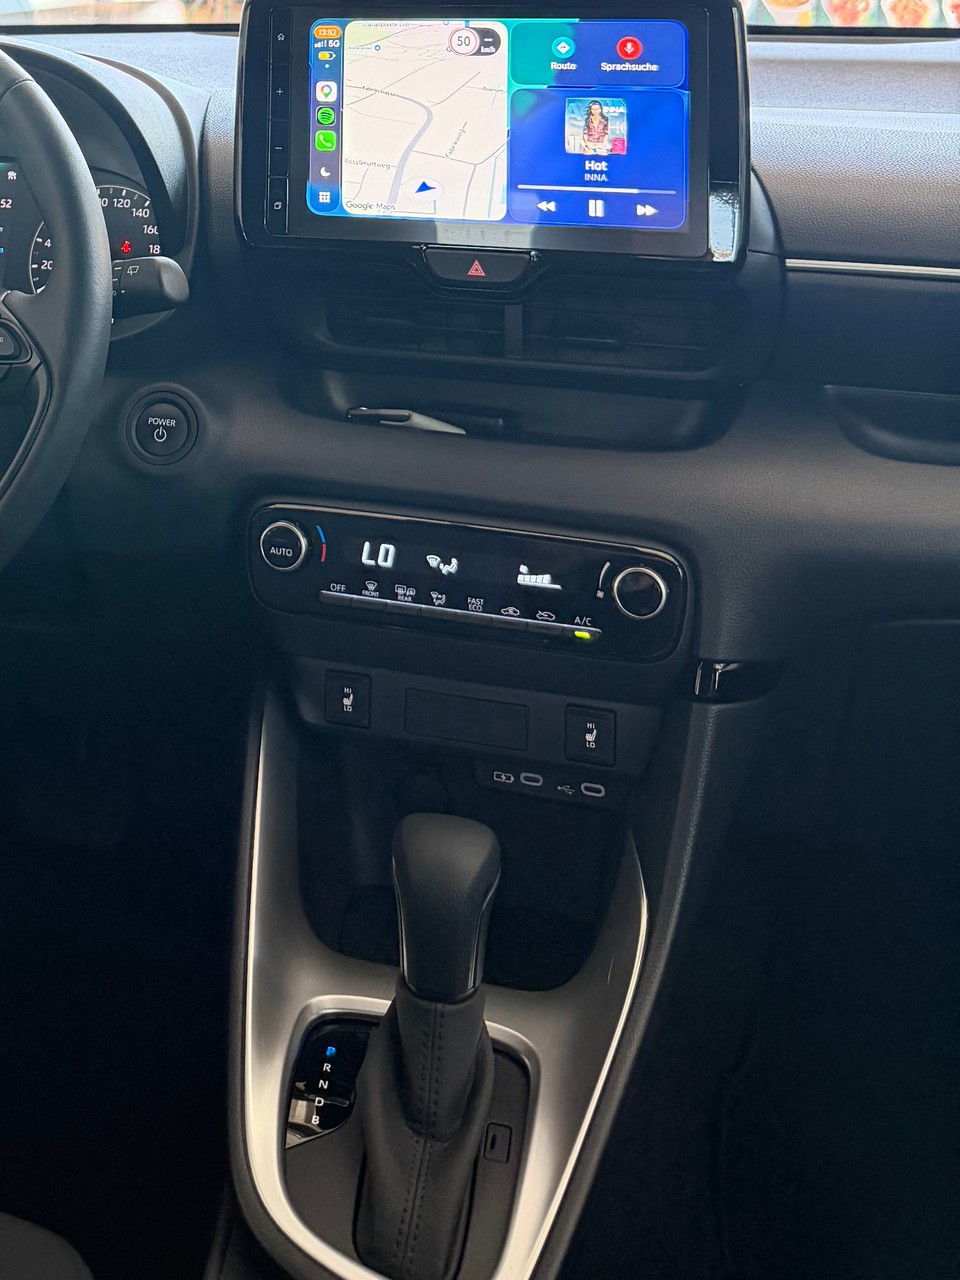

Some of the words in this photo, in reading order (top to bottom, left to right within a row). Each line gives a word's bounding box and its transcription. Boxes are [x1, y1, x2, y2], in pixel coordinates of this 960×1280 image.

[328, 39, 340, 48] 5G
[457, 36, 471, 47] 50
[551, 62, 577, 70] Route
[600, 62, 659, 72] Sprachsuche
[585, 160, 608, 171] Hot
[584, 173, 608, 182] INNA
[112, 198, 131, 208] 120
[345, 201, 374, 211] Google
[376, 202, 396, 211] Maps
[131, 208, 150, 218] 140
[148, 244, 160, 254] 18
[148, 417, 176, 427] POWER
[270, 546, 293, 557] AUTO
[361, 541, 396, 568] LO
[330, 583, 346, 592] OFF
[362, 590, 379, 598] FRONT
[397, 595, 412, 603] REAR
[467, 597, 484, 606] FAST
[468, 604, 483, 612] ECO
[574, 616, 592, 626] A/C
[323, 1063, 332, 1072] R
[318, 1080, 329, 1089] N
[315, 1097, 324, 1107] D
[311, 1115, 320, 1125] B
